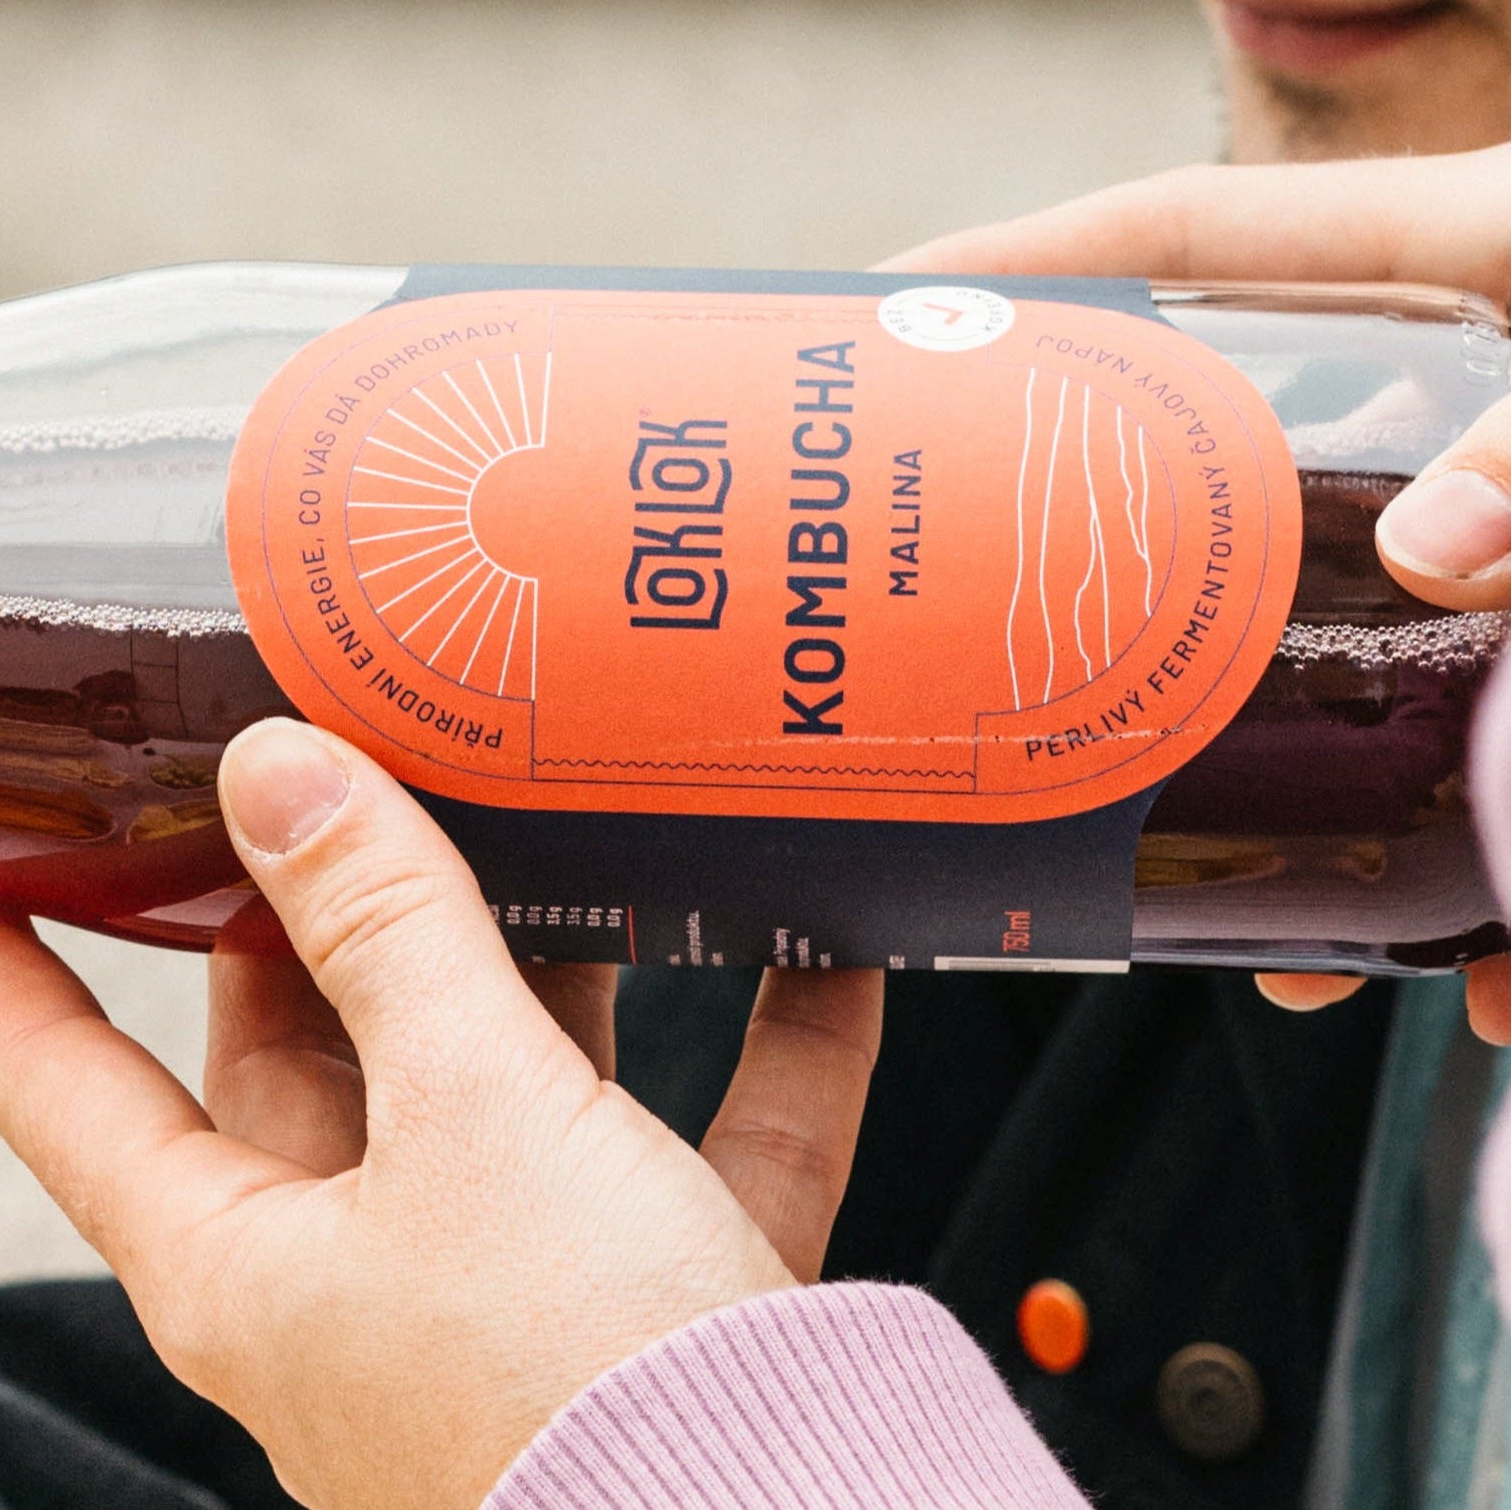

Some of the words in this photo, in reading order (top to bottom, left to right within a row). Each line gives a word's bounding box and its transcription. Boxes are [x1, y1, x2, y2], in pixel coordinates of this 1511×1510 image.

[354, 320, 518, 392] DOHROMADY
[1036, 335, 1134, 373] NÁPOJ
[325, 393, 361, 425] DÁ
[1134, 373, 1216, 454] ČAJOVÝ
[302, 430, 336, 477] VÁS
[298, 489, 322, 525] CO
[782, 340, 856, 735] KOMBUCHA
[888, 449, 922, 597] MALINA
[302, 538, 375, 670] ENERGIE,
[1146, 466, 1233, 694] FERMENTOVANÝ
[366, 668, 503, 748] PŘÍRODNÍ
[1026, 689, 1145, 761] PERLIVÝ
